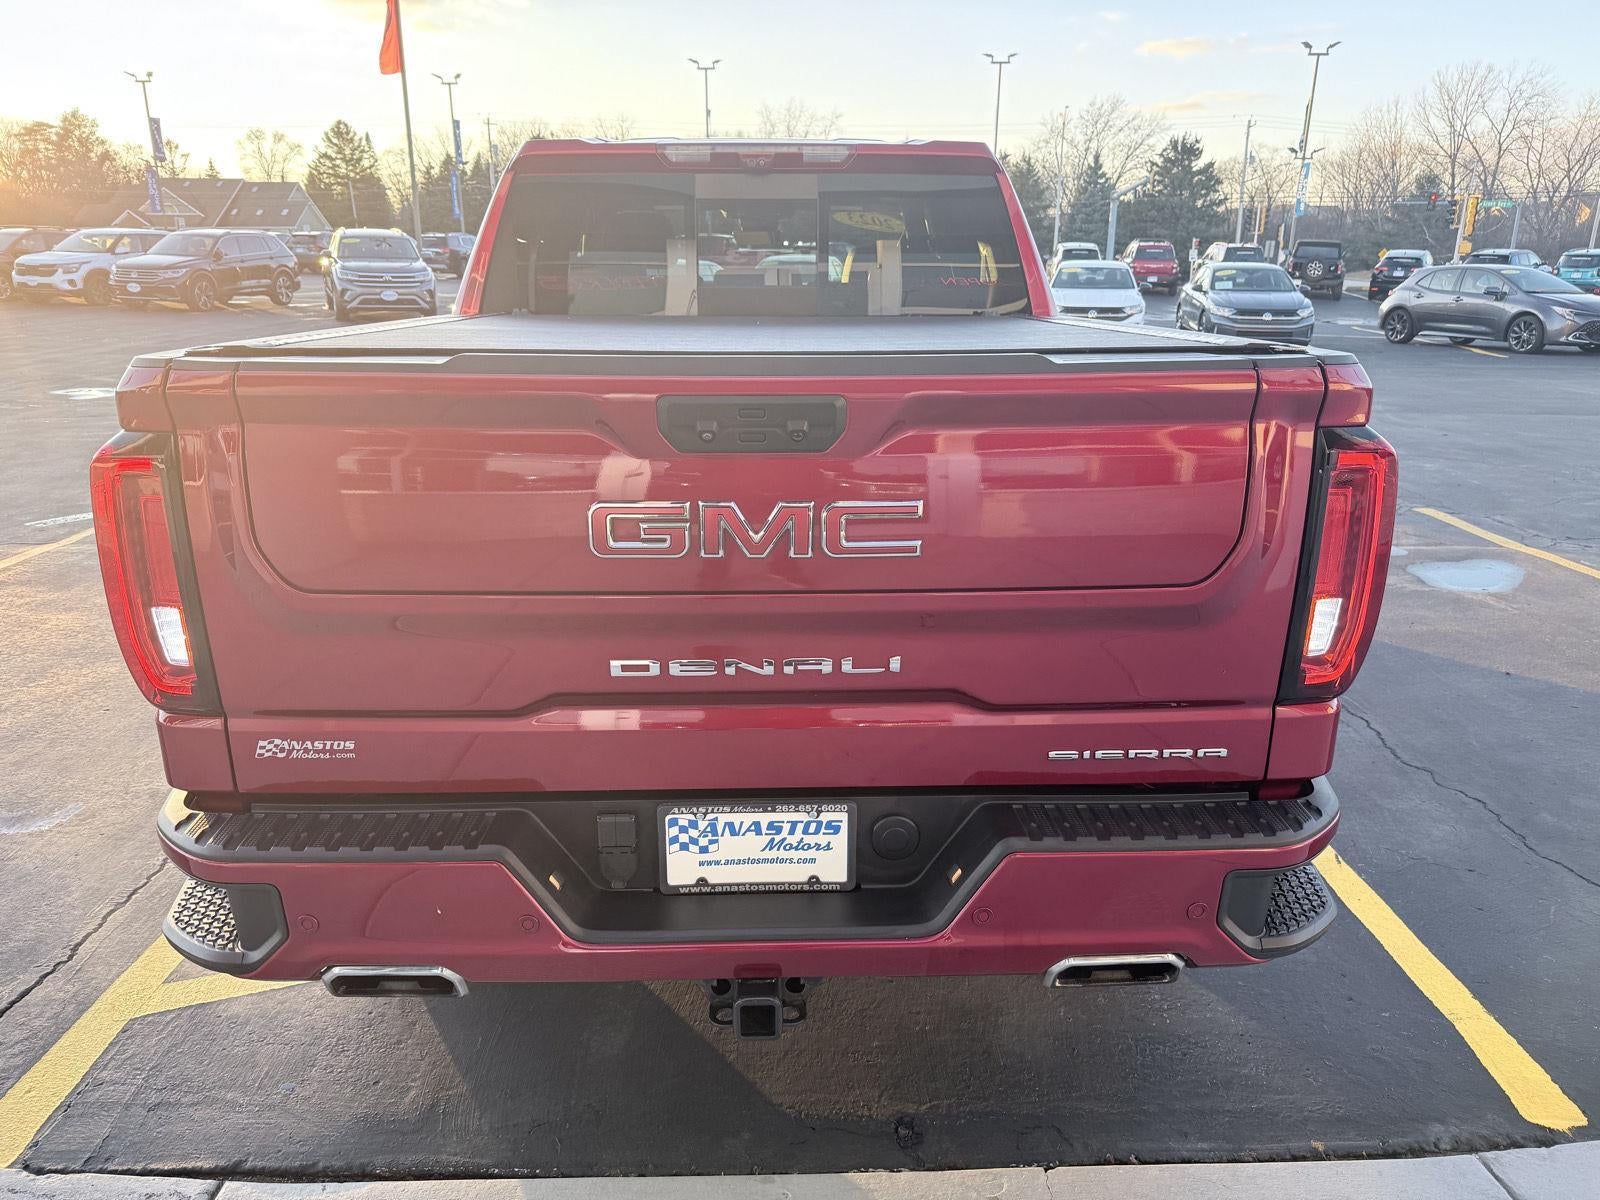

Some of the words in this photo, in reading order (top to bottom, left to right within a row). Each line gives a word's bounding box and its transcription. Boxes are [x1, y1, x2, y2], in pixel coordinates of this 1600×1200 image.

[588, 500, 924, 559] GMC
[609, 655, 902, 677] DENALI
[278, 739, 356, 750] ANASTOS
[1047, 748, 1228, 760] SIERRA
[670, 806, 731, 814] ANASTOS
[775, 804, 848, 813] 262-657-6020
[697, 816, 843, 838] ANASTOS
[759, 837, 834, 852] Motors
[698, 856, 817, 867] www.anastosmotors.com
[678, 883, 841, 894] www.anastosmotors.com
